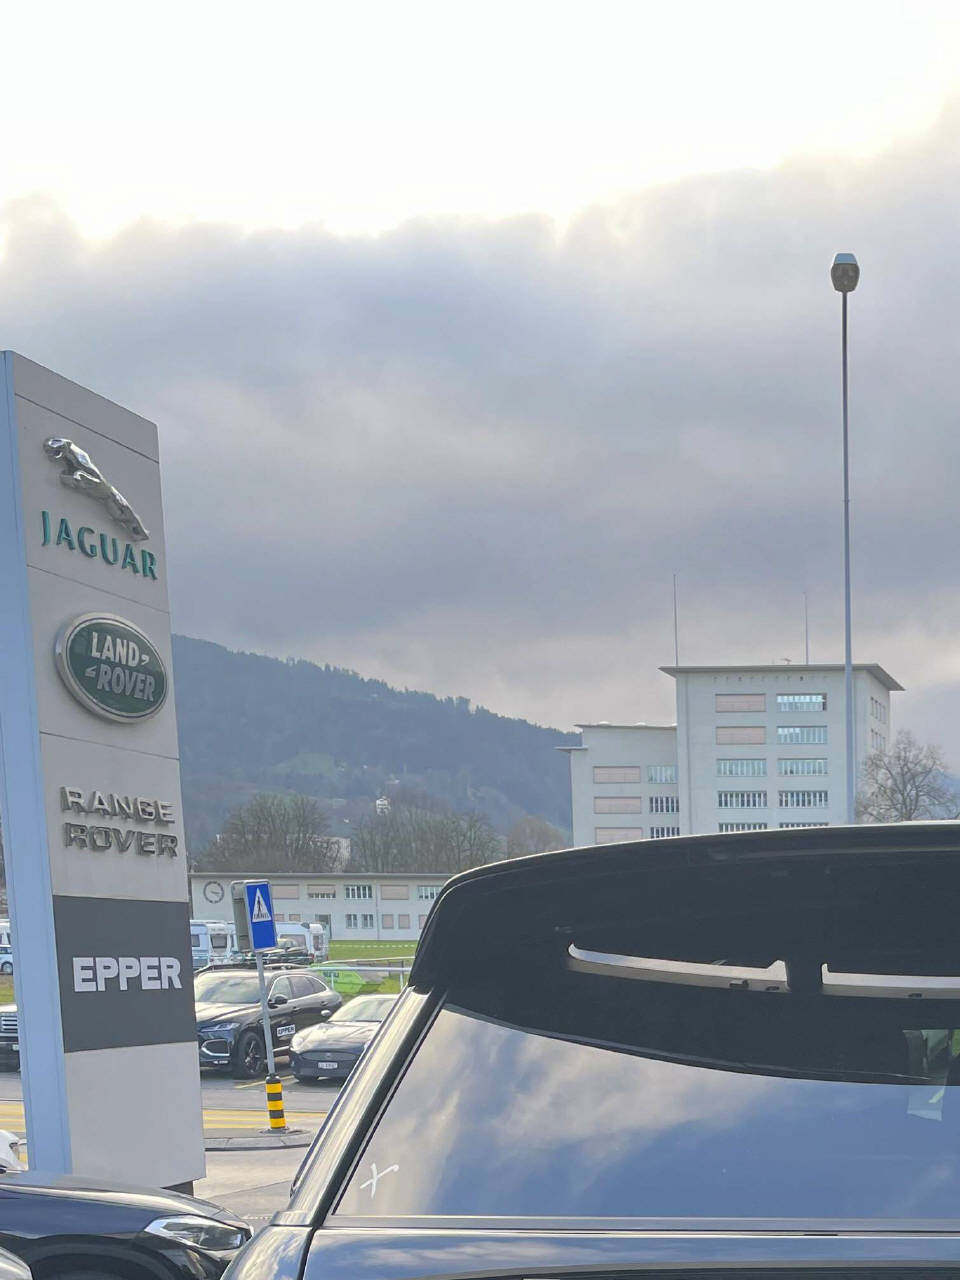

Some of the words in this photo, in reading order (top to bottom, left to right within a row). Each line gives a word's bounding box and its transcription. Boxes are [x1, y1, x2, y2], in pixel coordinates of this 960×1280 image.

[41, 510, 158, 580] JAGUAR
[91, 631, 140, 665] LAND
[97, 666, 155, 702] ROVER
[60, 786, 175, 824] RANGE
[64, 822, 178, 857] ROVER
[72, 957, 183, 992] EPPER
